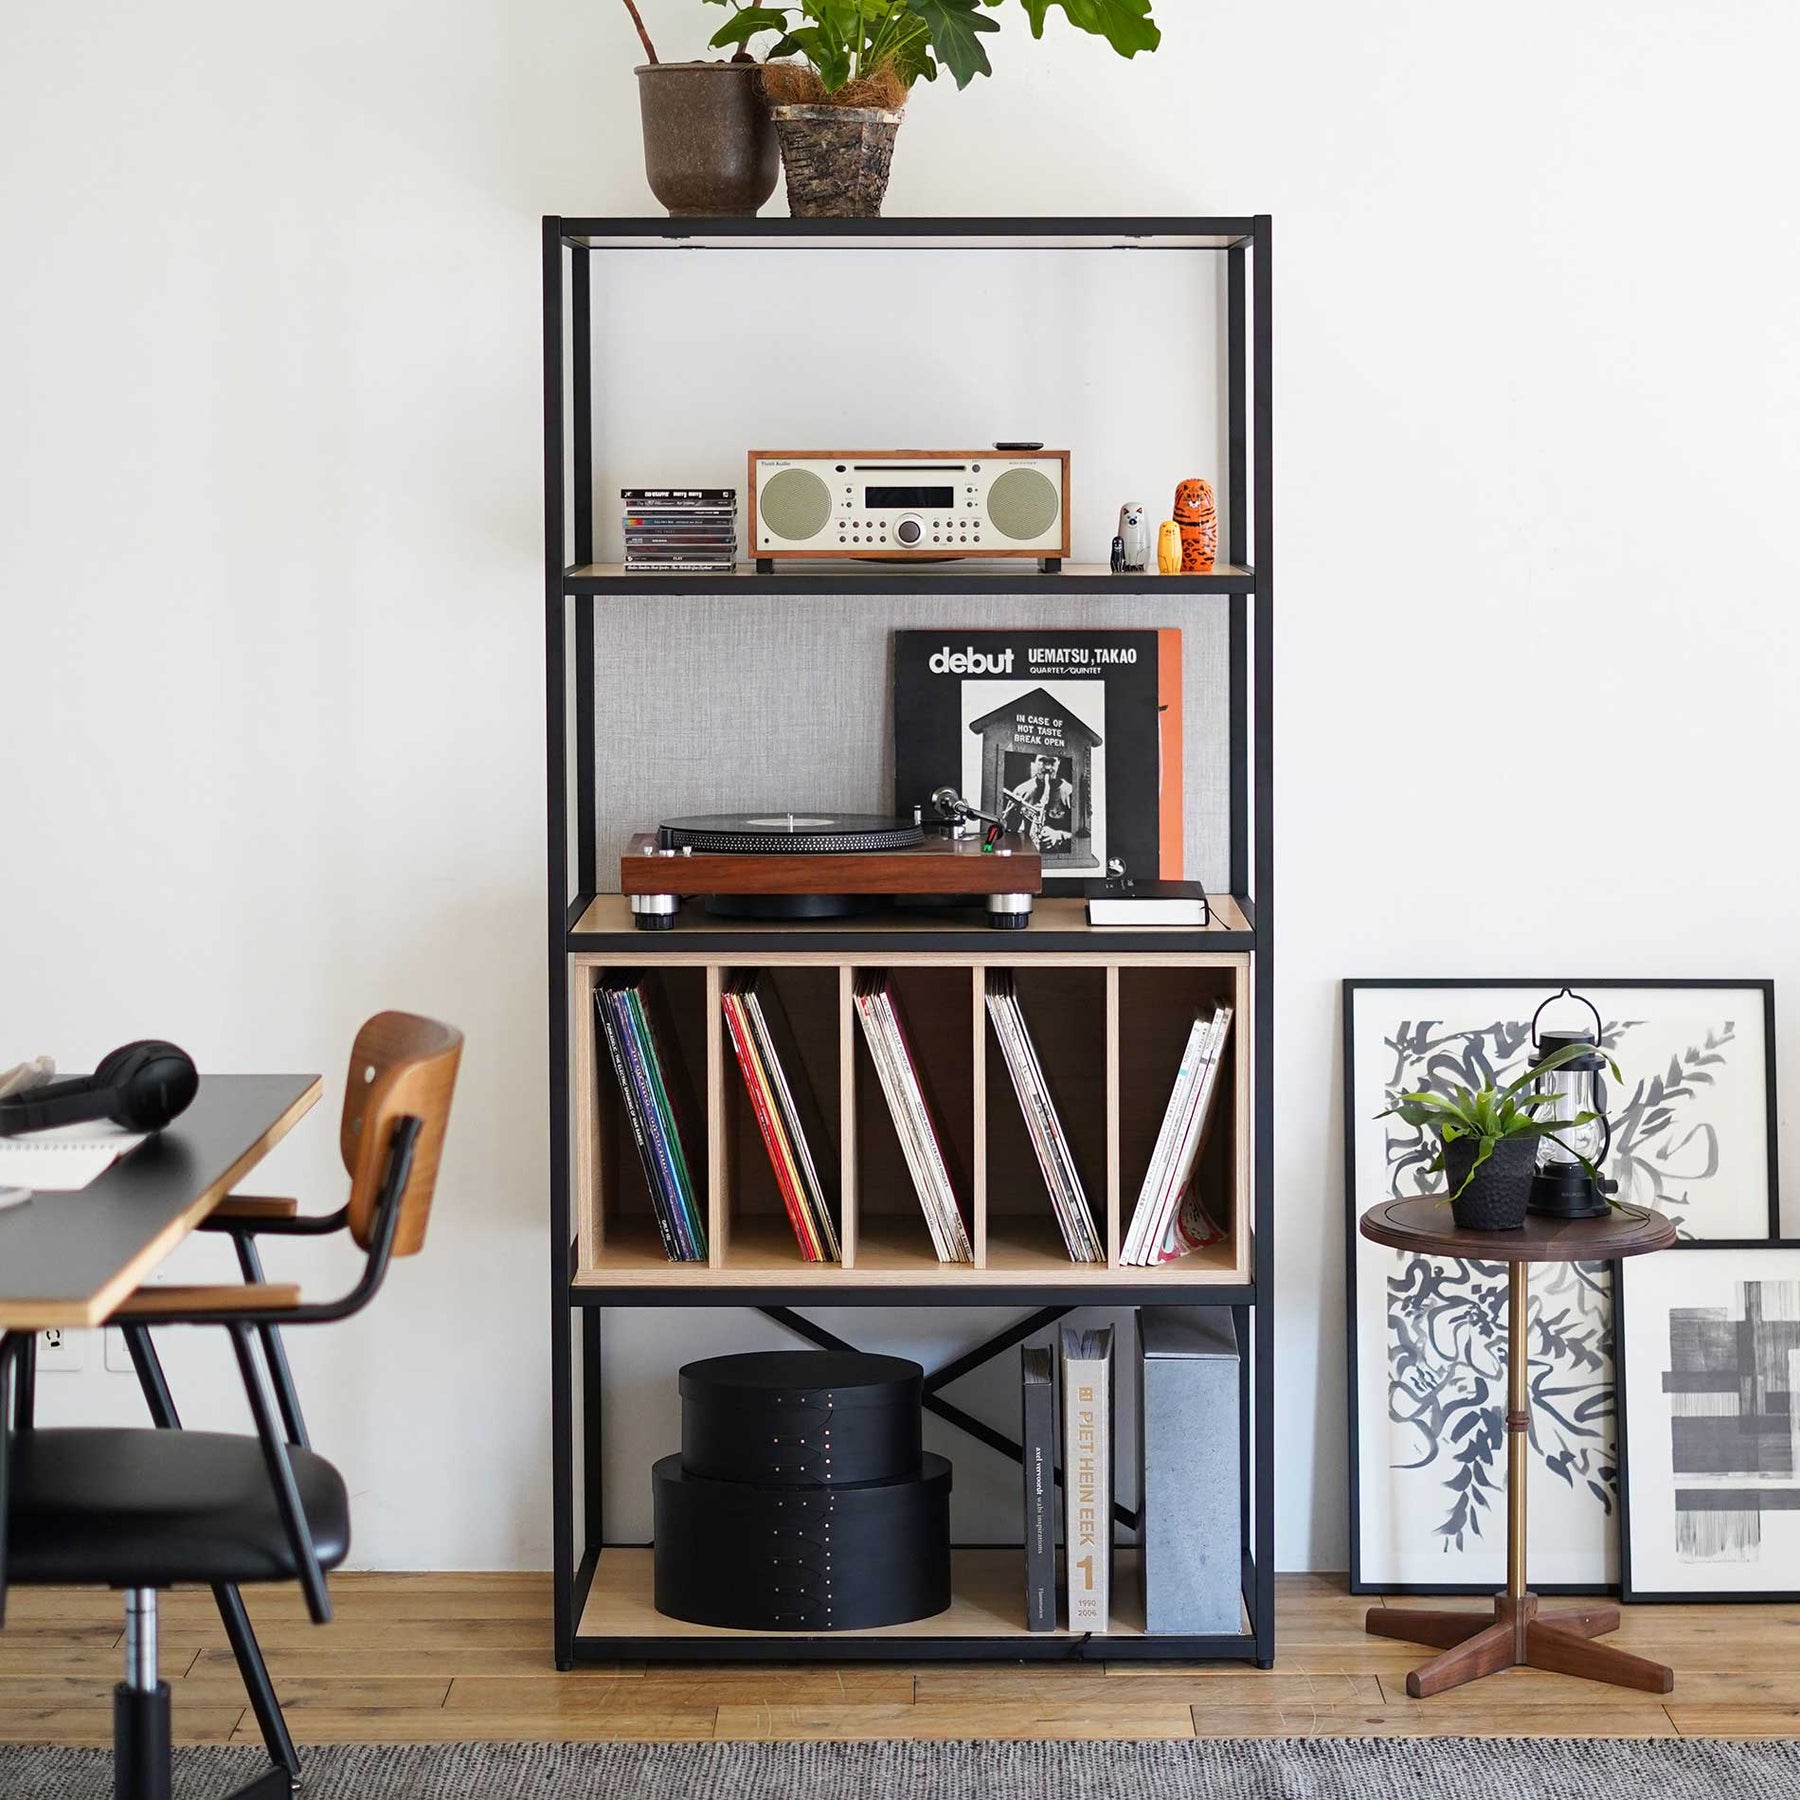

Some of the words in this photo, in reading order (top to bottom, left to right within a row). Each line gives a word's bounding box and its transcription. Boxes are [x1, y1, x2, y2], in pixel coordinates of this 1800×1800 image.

[928, 646, 1015, 674] debut
[1029, 667, 1101, 675] QUARTET/QUINTET
[1016, 714, 1026, 724] IN
[1027, 716, 1050, 726] CASE
[1052, 719, 1063, 728] OF
[1017, 725, 1034, 734] HOT
[1037, 727, 1062, 738] TASTE
[1014, 734, 1042, 746] BREAK
[1043, 737, 1065, 748] OPEN
[1078, 1411, 1094, 1453] PIET
[1035, 1446, 1043, 1463] axel
[1079, 1459, 1094, 1503] HEIN
[1037, 1496, 1045, 1513] wabi
[1037, 1514, 1045, 1554] inspirations
[1079, 1508, 1095, 1548] EEK
[1076, 1555, 1093, 1590] 1
[1078, 1599, 1096, 1607] 1990
